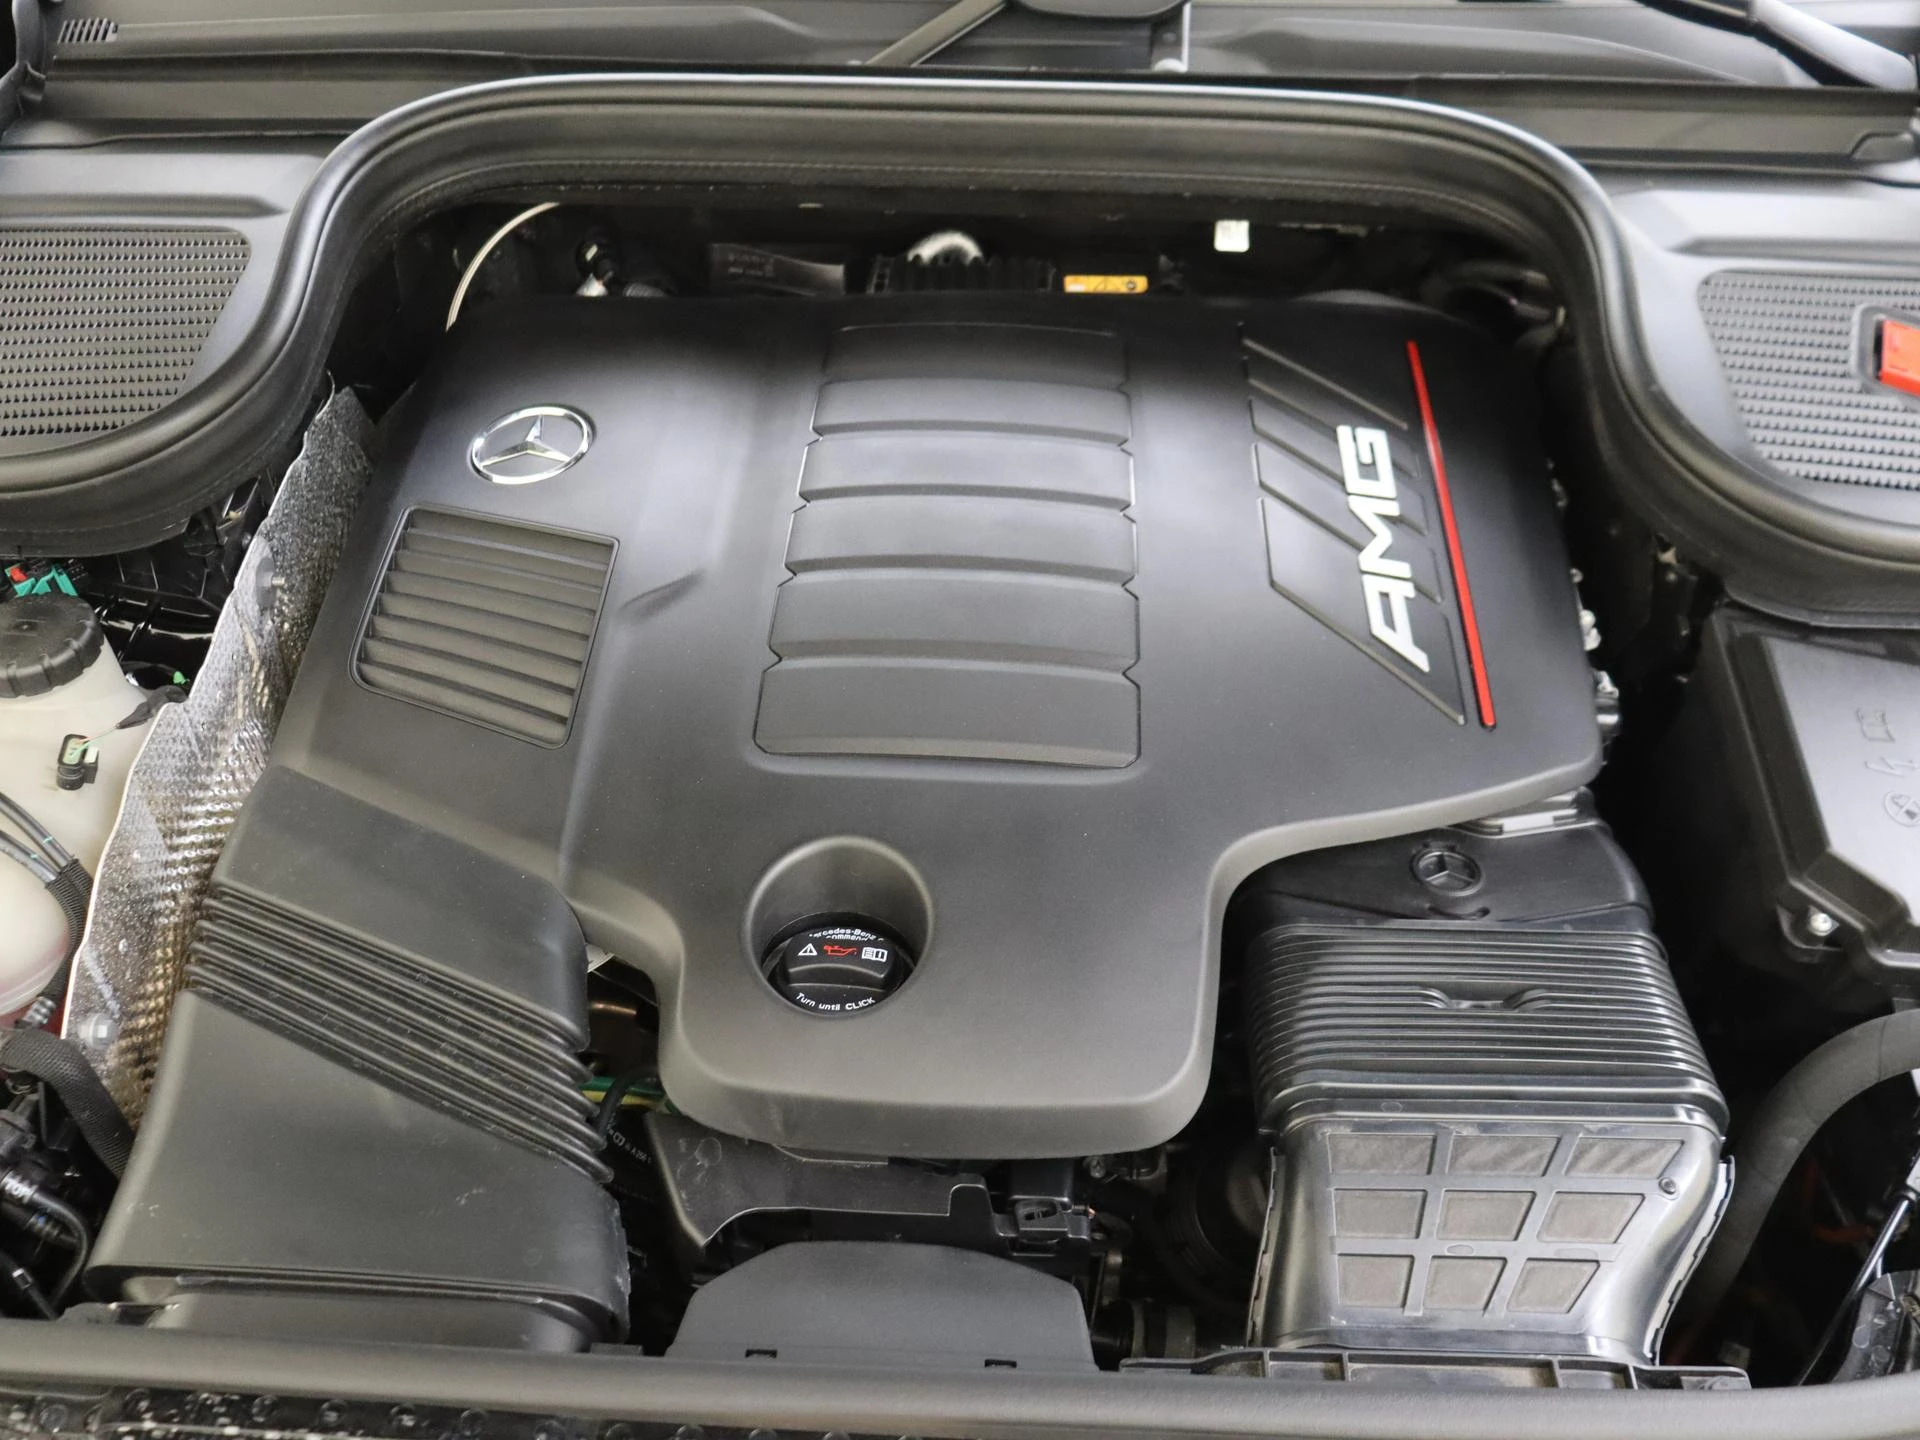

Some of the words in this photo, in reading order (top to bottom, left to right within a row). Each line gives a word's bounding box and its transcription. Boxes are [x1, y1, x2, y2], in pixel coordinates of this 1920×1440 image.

[1336, 424, 1430, 673] AMG
[796, 993, 816, 1007] Turn
[818, 1003, 840, 1011] until
[845, 996, 876, 1010] CLICK
